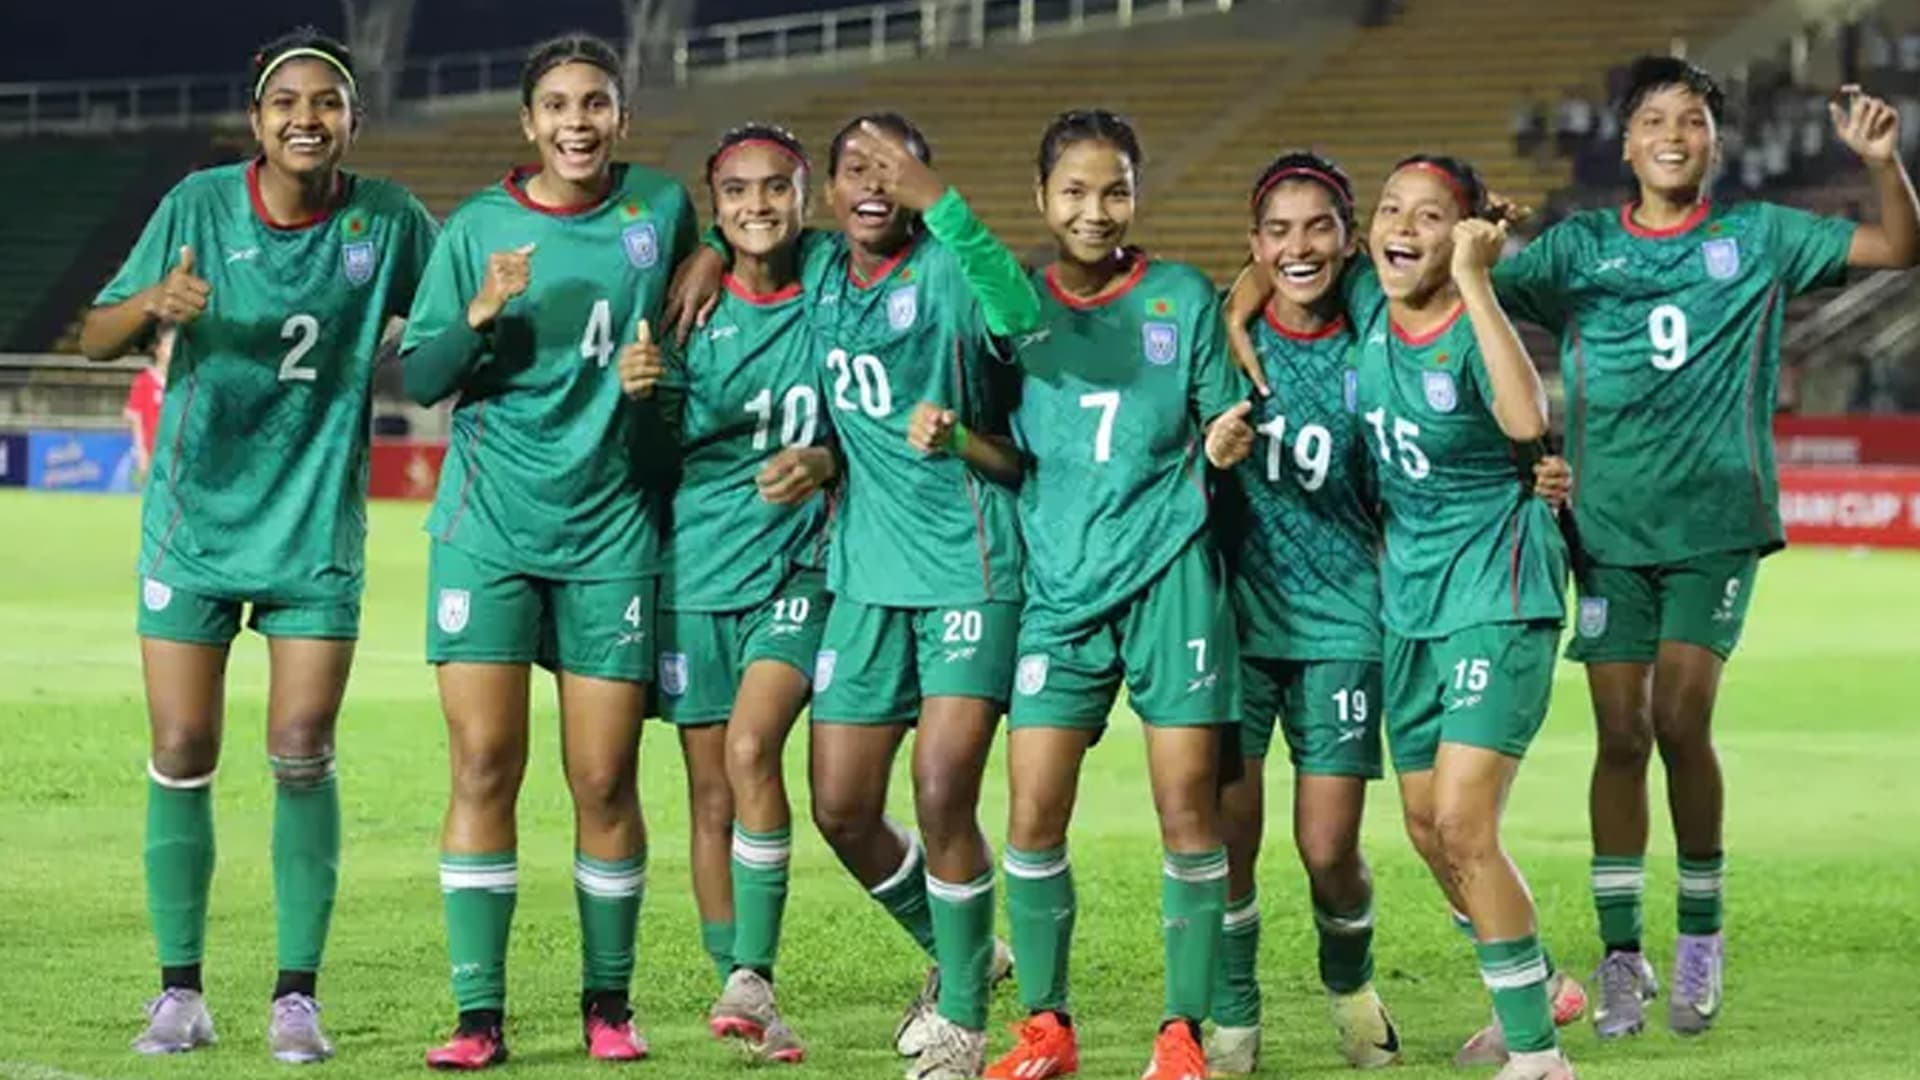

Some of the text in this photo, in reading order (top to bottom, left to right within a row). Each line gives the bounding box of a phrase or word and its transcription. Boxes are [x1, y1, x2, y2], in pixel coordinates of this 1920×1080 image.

[278, 314, 318, 380] 2
[580, 299, 614, 367] 4
[1649, 303, 1688, 371] 9
[826, 347, 892, 419] 20
[744, 384, 819, 449] 10
[1079, 391, 1121, 463] 7
[1364, 406, 1432, 480] 15
[1257, 414, 1333, 491] 19
[624, 596, 640, 627] 4
[772, 597, 809, 624] 10
[942, 609, 983, 643] 20
[1187, 638, 1206, 672] 7
[1453, 658, 1489, 692] 15
[1332, 688, 1367, 722] 19
